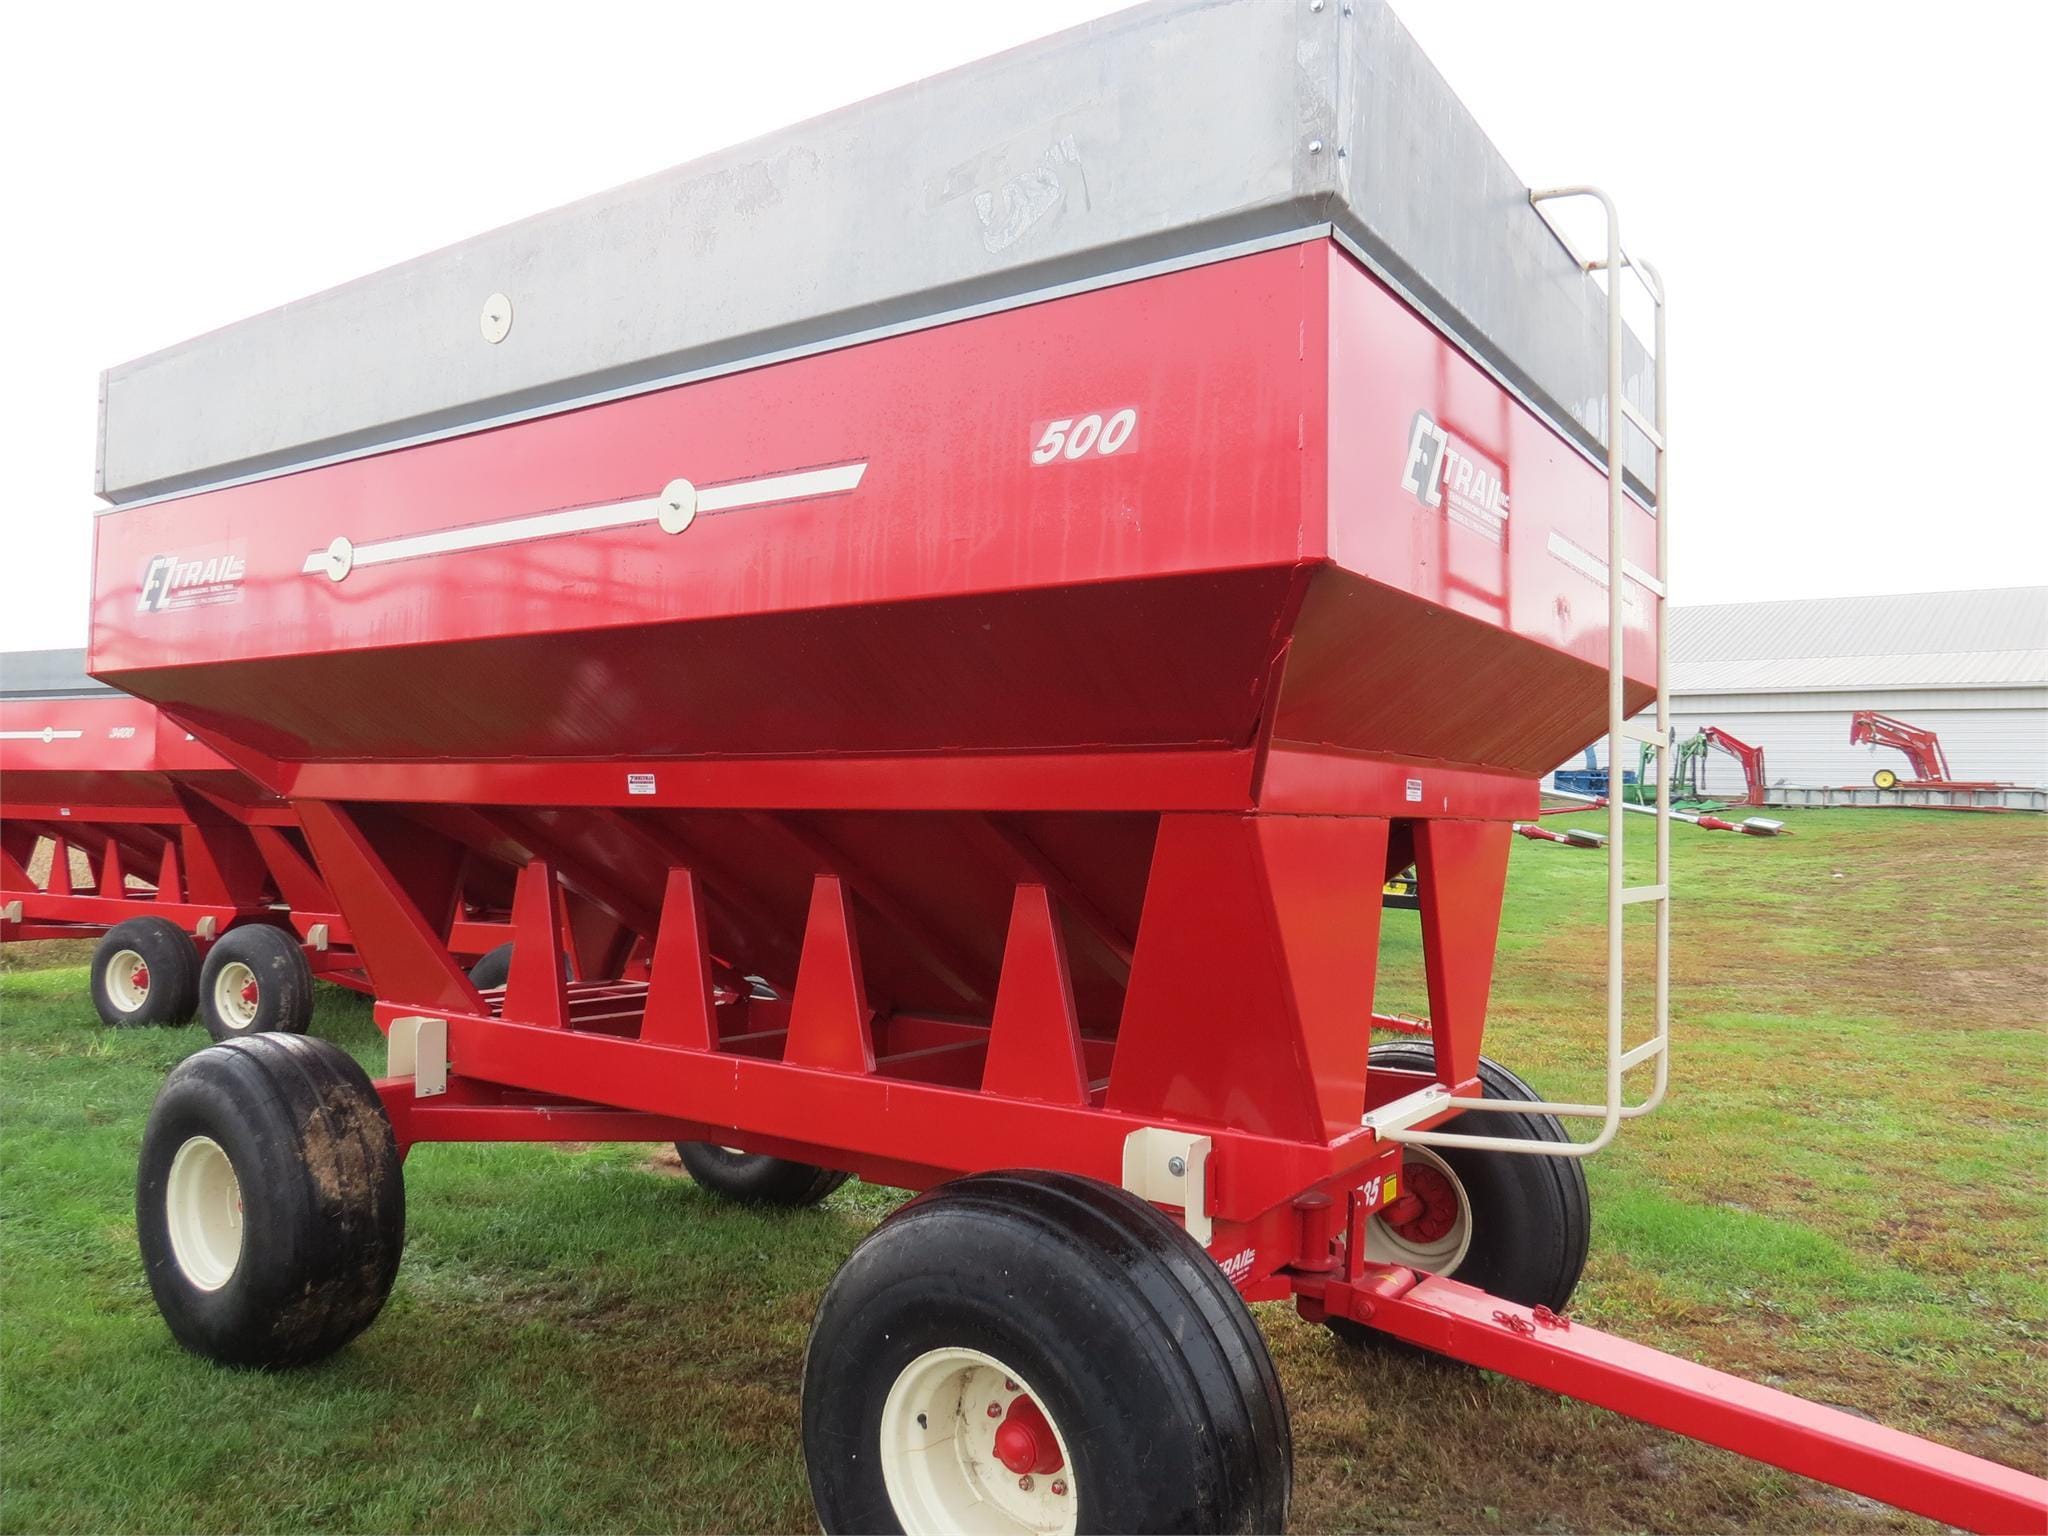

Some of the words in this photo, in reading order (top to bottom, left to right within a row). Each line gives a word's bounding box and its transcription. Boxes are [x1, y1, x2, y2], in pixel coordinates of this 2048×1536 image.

[1031, 408, 1137, 465] 500
[1442, 446, 1509, 521] TRAIL
[171, 555, 243, 588] TRAIL
